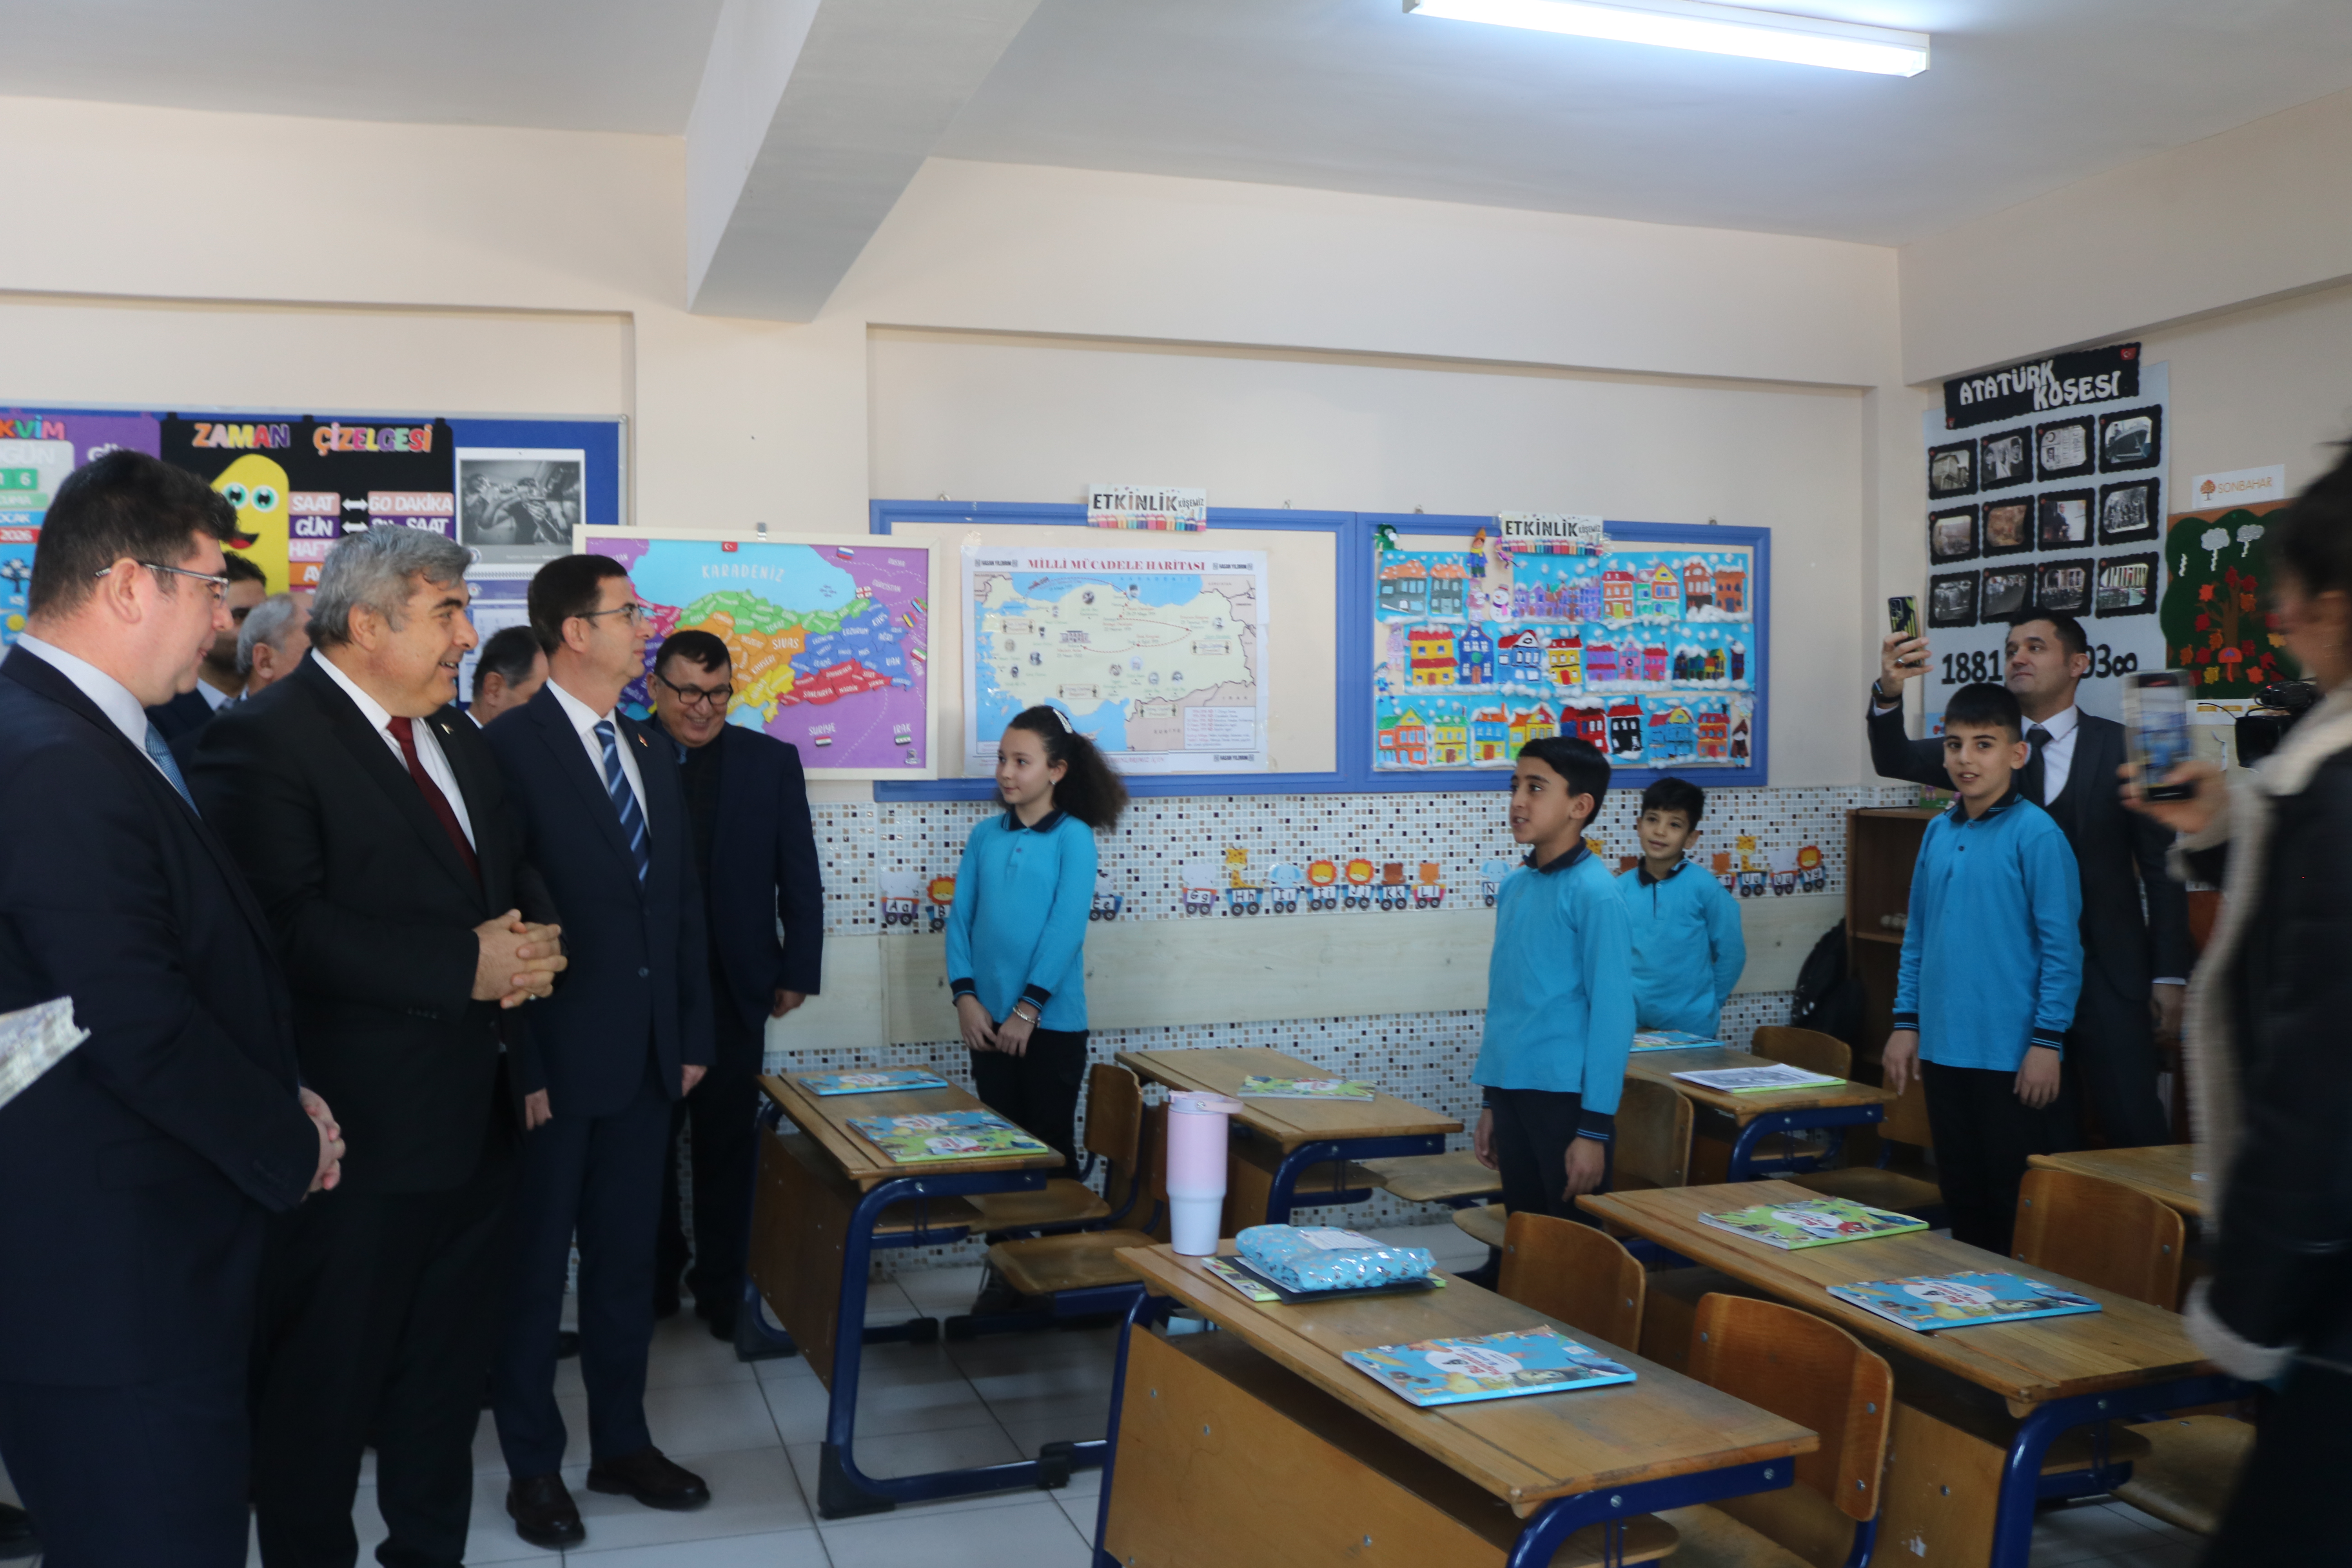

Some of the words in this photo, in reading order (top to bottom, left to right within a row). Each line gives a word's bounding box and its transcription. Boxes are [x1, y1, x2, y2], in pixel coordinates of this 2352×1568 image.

[1960, 359, 2056, 405] ATATÜRK
[192, 423, 290, 448] ZAMAN
[314, 422, 433, 456] ÇİZELGESİ
[2218, 477, 2272, 494] SONBAHAR
[292, 495, 335, 512] SAAT
[369, 497, 391, 511] 60
[395, 493, 453, 512] DAKİKA
[1093, 491, 1178, 512] ETKİNLİK
[1178, 497, 1204, 509] KÖŞEMİZ
[295, 516, 333, 537] GÜN
[1505, 518, 1578, 537] ETKİNLİK
[702, 563, 784, 583] KARADENİZ
[1028, 558, 1067, 570] MİLLİ
[1071, 558, 1143, 571] MÜCADELE
[1146, 559, 1206, 571] HARİTASI
[772, 637, 800, 650] SİVAS
[886, 656, 901, 666] VAN
[1942, 650, 2002, 684] 1881
[893, 723, 912, 735] IRAK
